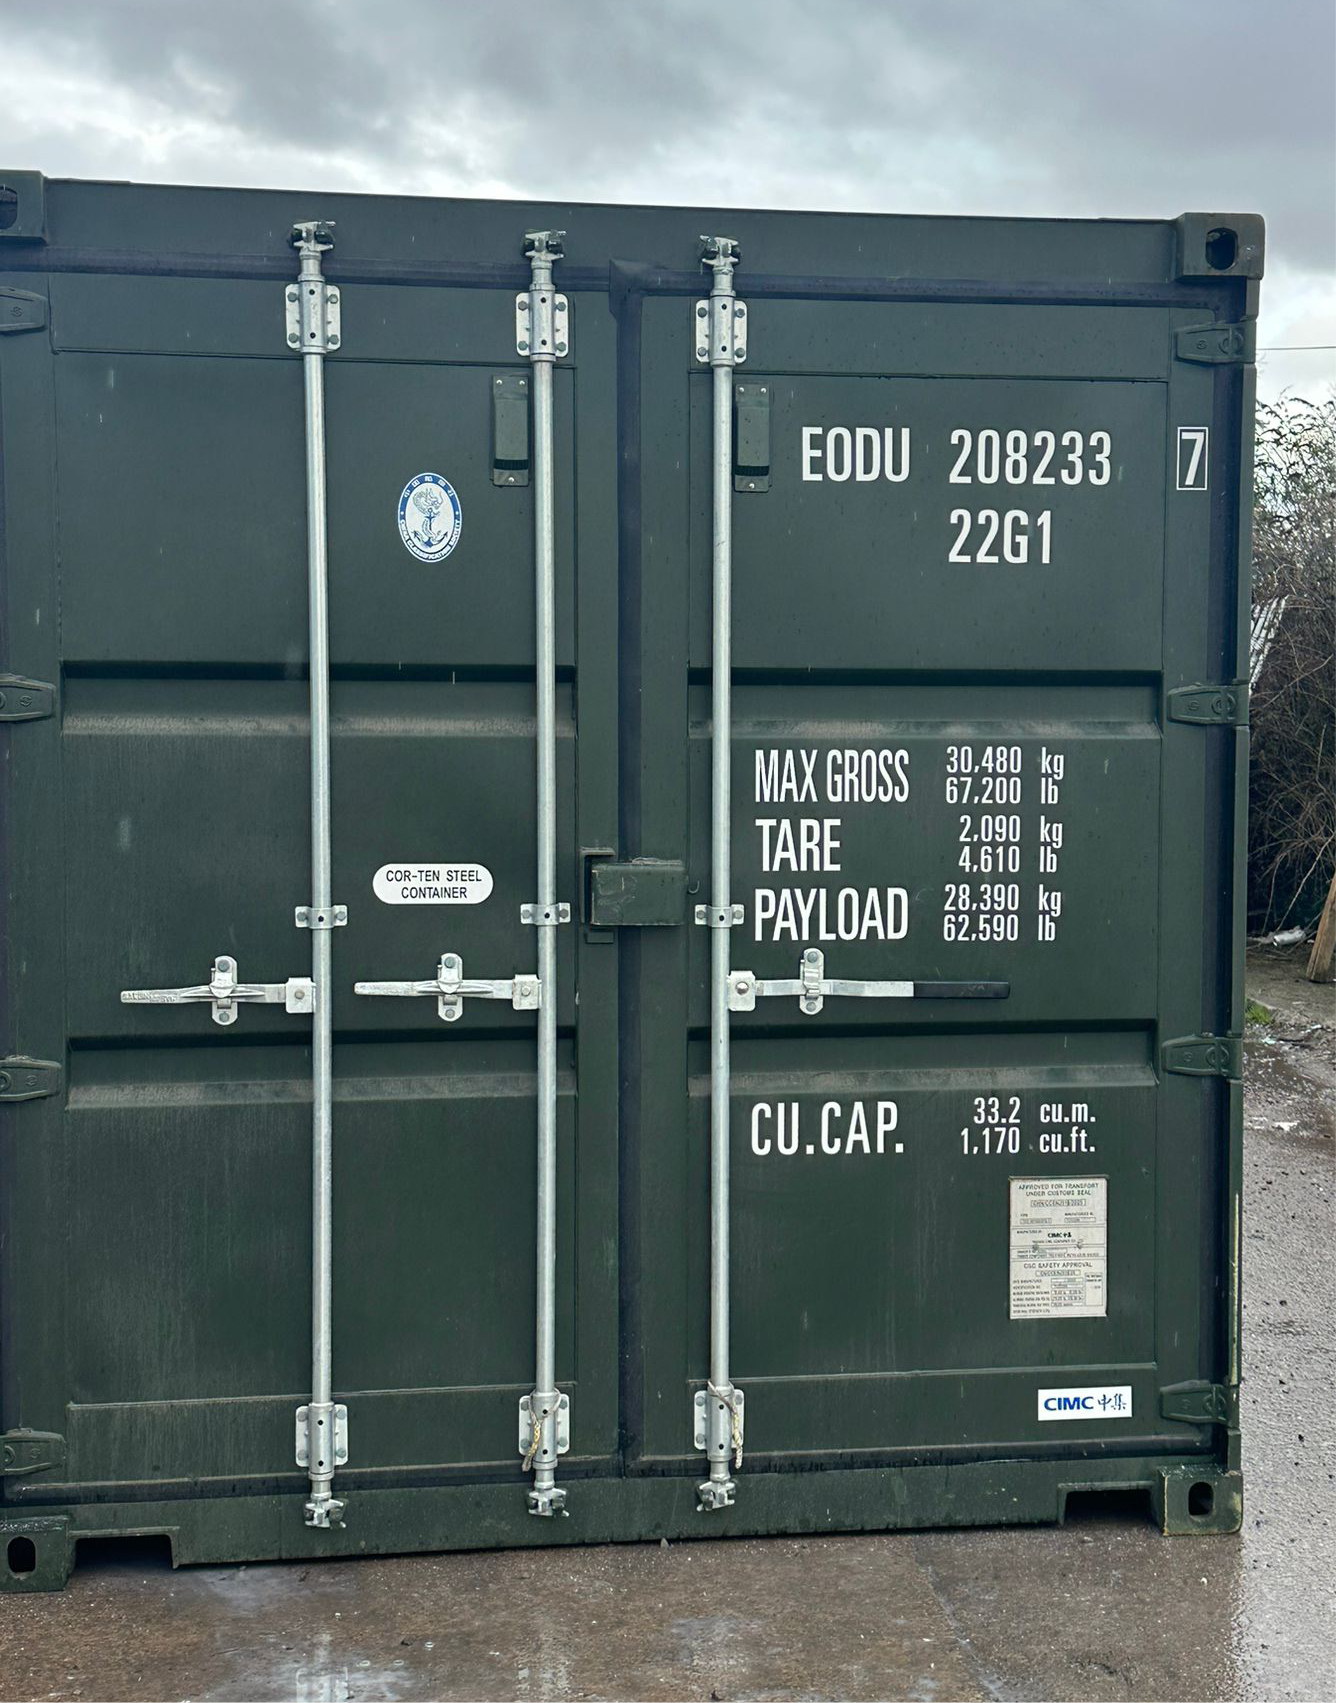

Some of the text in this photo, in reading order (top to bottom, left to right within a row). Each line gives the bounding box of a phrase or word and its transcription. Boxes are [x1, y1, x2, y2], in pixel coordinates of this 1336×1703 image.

[801, 426, 1205, 486] EODU 208233 7
[948, 508, 1052, 564] 22G1
[755, 748, 910, 803] MAX GROSS
[946, 745, 1065, 780] 30,480 kg
[945, 776, 1059, 804] 67,200 lb
[755, 818, 842, 872] TARE
[959, 814, 1063, 849] 2,090 kg
[386, 870, 482, 882] COR-TEN STEEL
[958, 845, 1058, 873] 4,610 lb
[401, 886, 468, 899] CONTAINER
[943, 883, 1062, 917] 28,390 kg
[754, 887, 909, 942] PAYLOAD
[943, 914, 1056, 942] 62,590 lb
[973, 1096, 1097, 1124] 33.2 cu.m.
[751, 1101, 904, 1156] CU.CAP.
[960, 1126, 1096, 1155] 1,170 cu.ft.
[1044, 1396, 1094, 1411] CIMC
